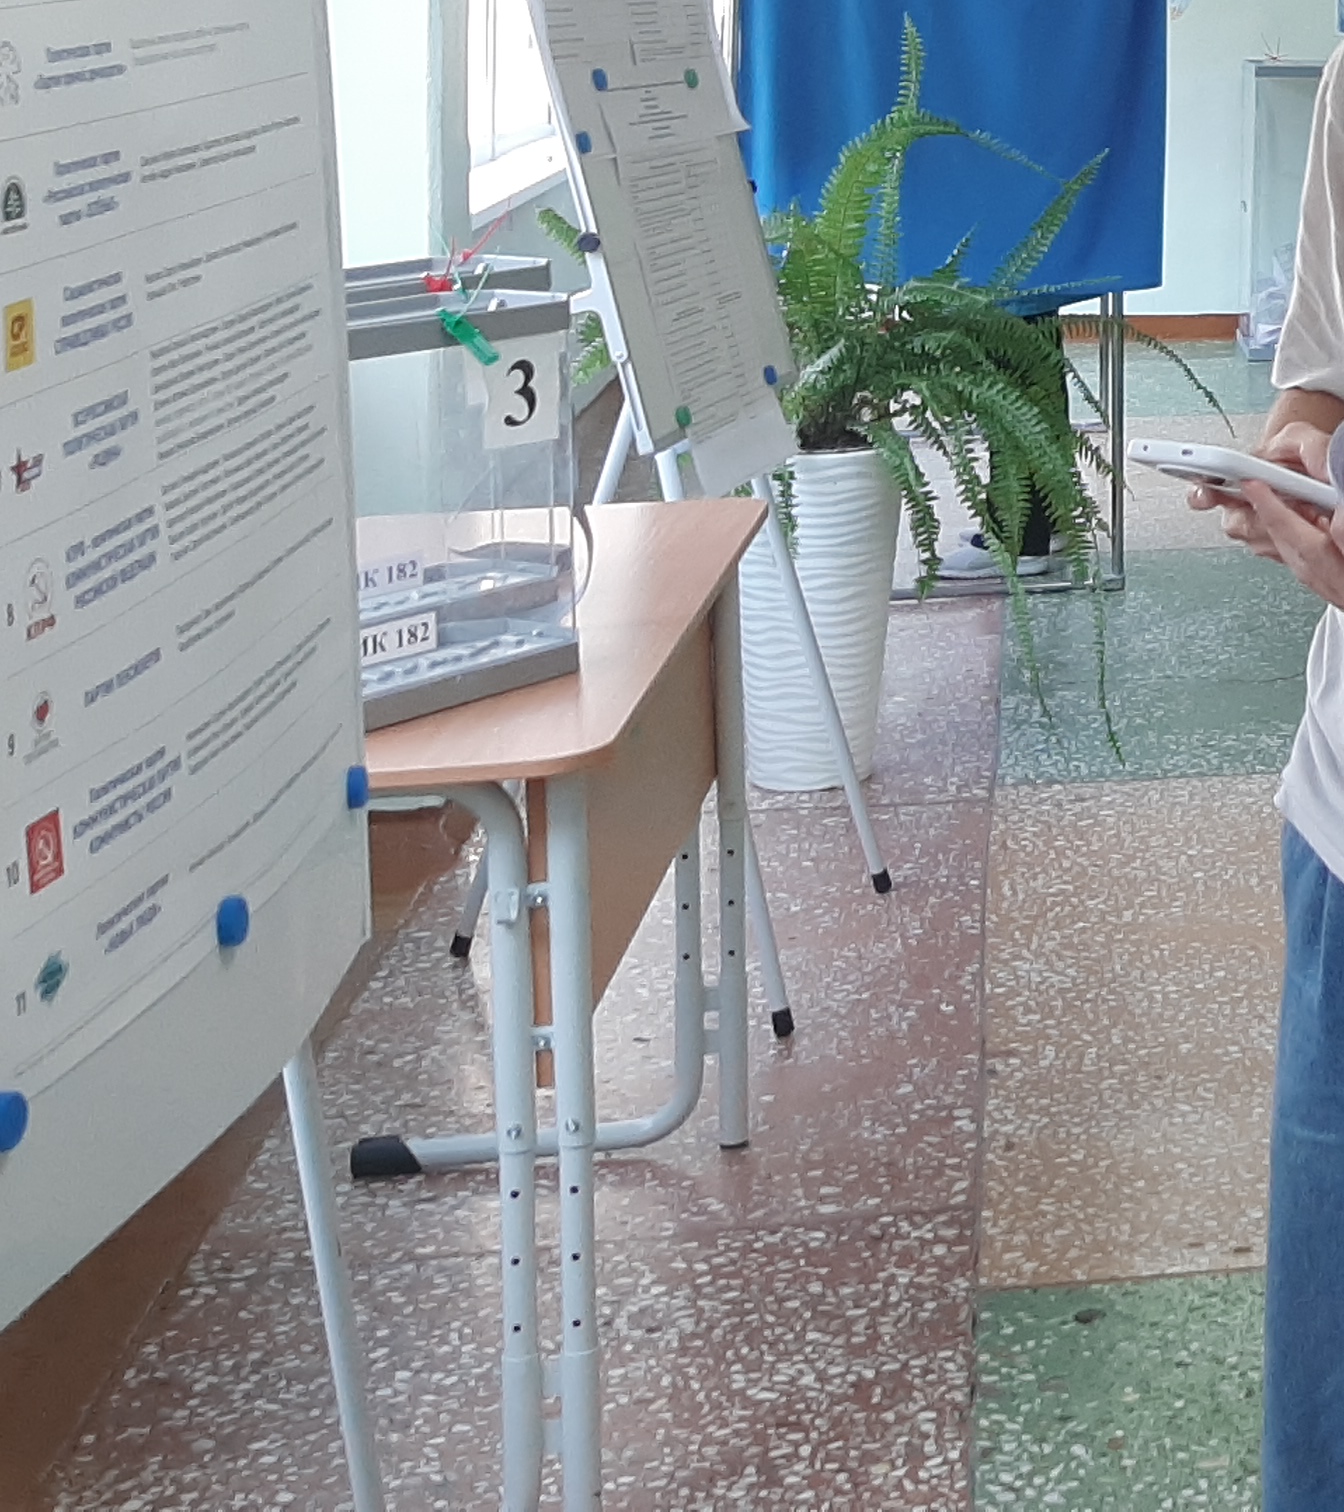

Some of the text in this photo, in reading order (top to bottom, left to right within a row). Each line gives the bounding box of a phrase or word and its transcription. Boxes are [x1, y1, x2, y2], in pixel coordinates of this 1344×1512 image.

[503, 358, 537, 427] 3
[386, 558, 419, 585] 182
[395, 620, 431, 650] 182
